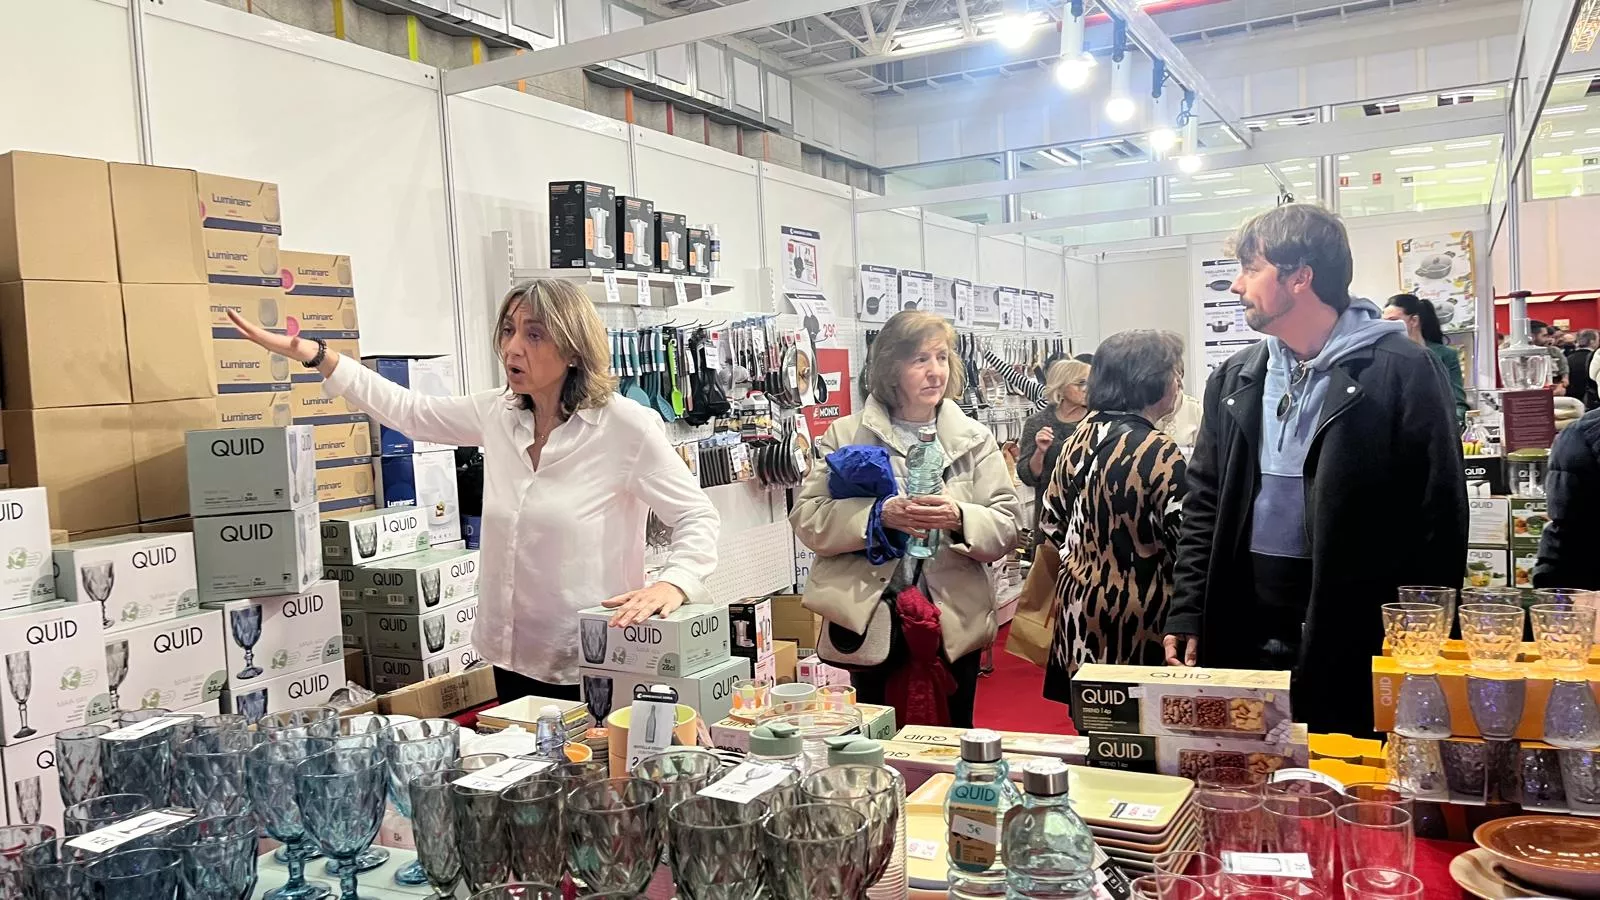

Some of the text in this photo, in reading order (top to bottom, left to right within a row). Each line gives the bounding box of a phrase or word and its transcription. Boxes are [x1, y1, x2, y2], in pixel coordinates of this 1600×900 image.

[211, 193, 252, 208] Luminarc
[207, 249, 249, 262] Luminarc
[298, 267, 329, 277] Luminarc
[302, 312, 334, 321] Luminarc
[220, 359, 261, 369] Luminarc
[221, 412, 263, 423] Luminarc
[820, 407, 839, 417] MONIX
[211, 437, 265, 458] QUID
[314, 440, 346, 451] Luminarc
[220, 523, 274, 543] QUID
[389, 516, 418, 534] QUID
[132, 546, 177, 569] QUID
[326, 568, 354, 583] QUID
[450, 560, 476, 579] QUID
[373, 572, 404, 587] QUID
[282, 594, 324, 618] QUID
[26, 620, 78, 645] QUID
[379, 617, 408, 632] QUID
[690, 615, 719, 638] QUID
[153, 626, 203, 654] QUID
[623, 625, 662, 645] QUID
[383, 661, 411, 676] QUID
[1149, 672, 1213, 681] QUID
[288, 674, 329, 700] QUID
[1380, 676, 1394, 706] QUID
[1081, 688, 1127, 705] QUID
[1097, 741, 1143, 759] QUID
[955, 785, 996, 801] QUID
